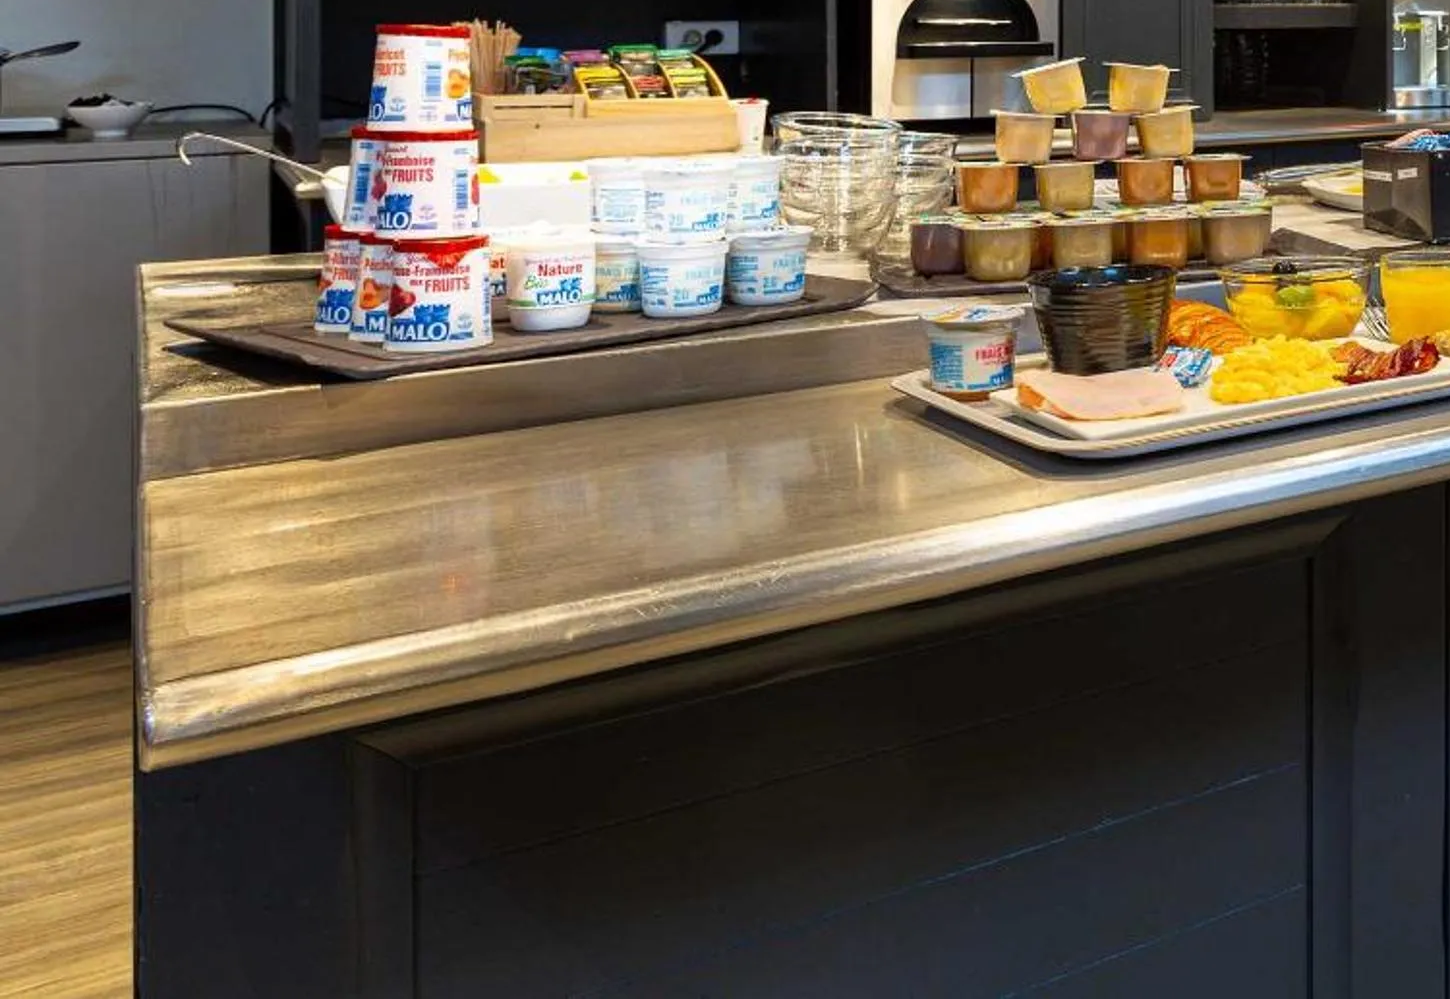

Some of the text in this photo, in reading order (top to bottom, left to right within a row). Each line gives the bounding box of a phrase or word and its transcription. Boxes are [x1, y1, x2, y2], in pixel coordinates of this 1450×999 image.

[392, 168, 434, 183] FRUITS
[537, 263, 583, 277] Nature
[424, 276, 471, 293] FRUITS
[536, 290, 582, 305] MALO
[391, 322, 448, 341] MALO
